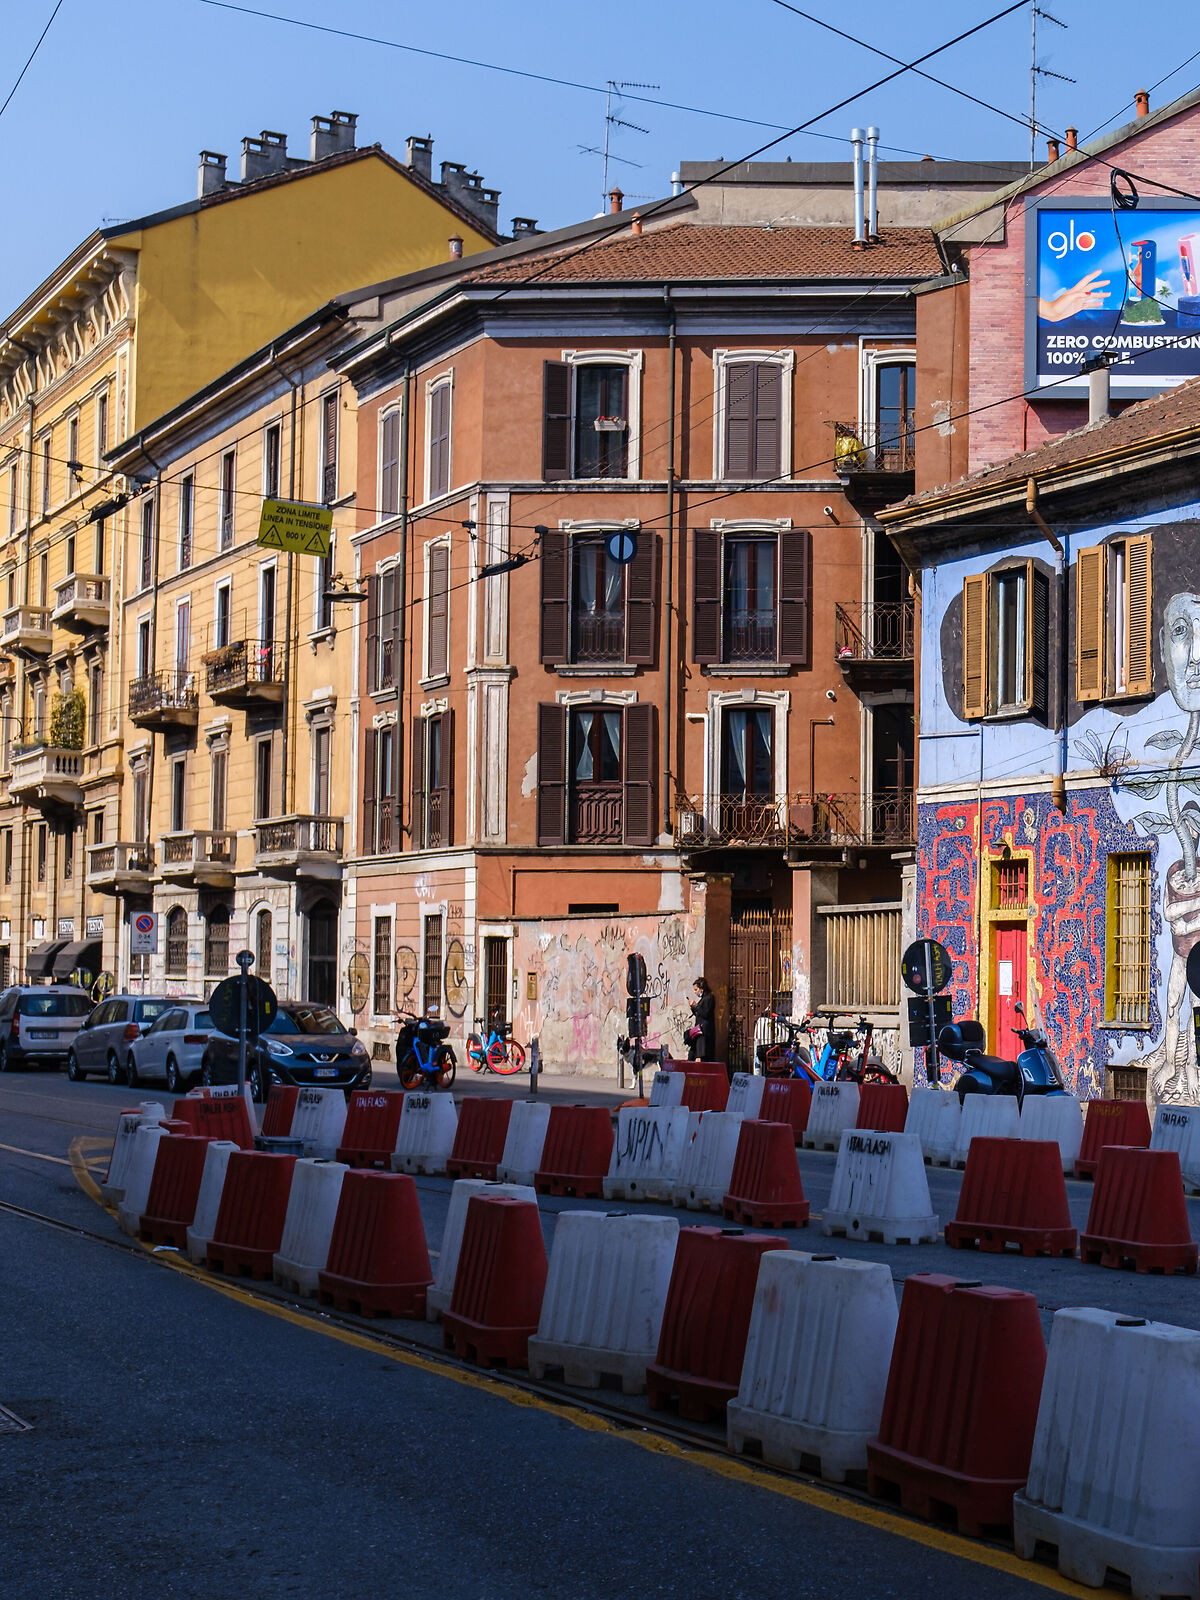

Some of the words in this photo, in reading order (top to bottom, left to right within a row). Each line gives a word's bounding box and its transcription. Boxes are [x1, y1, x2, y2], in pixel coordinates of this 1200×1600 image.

[1047, 219, 1095, 259] glo
[1046, 335, 1090, 349] ZERO
[1046, 352, 1086, 365] 100%
[276, 506, 297, 516] ZONA
[298, 510, 321, 520] LIMITE
[263, 514, 284, 523] LINEA
[296, 519, 329, 531] TENSIONE
